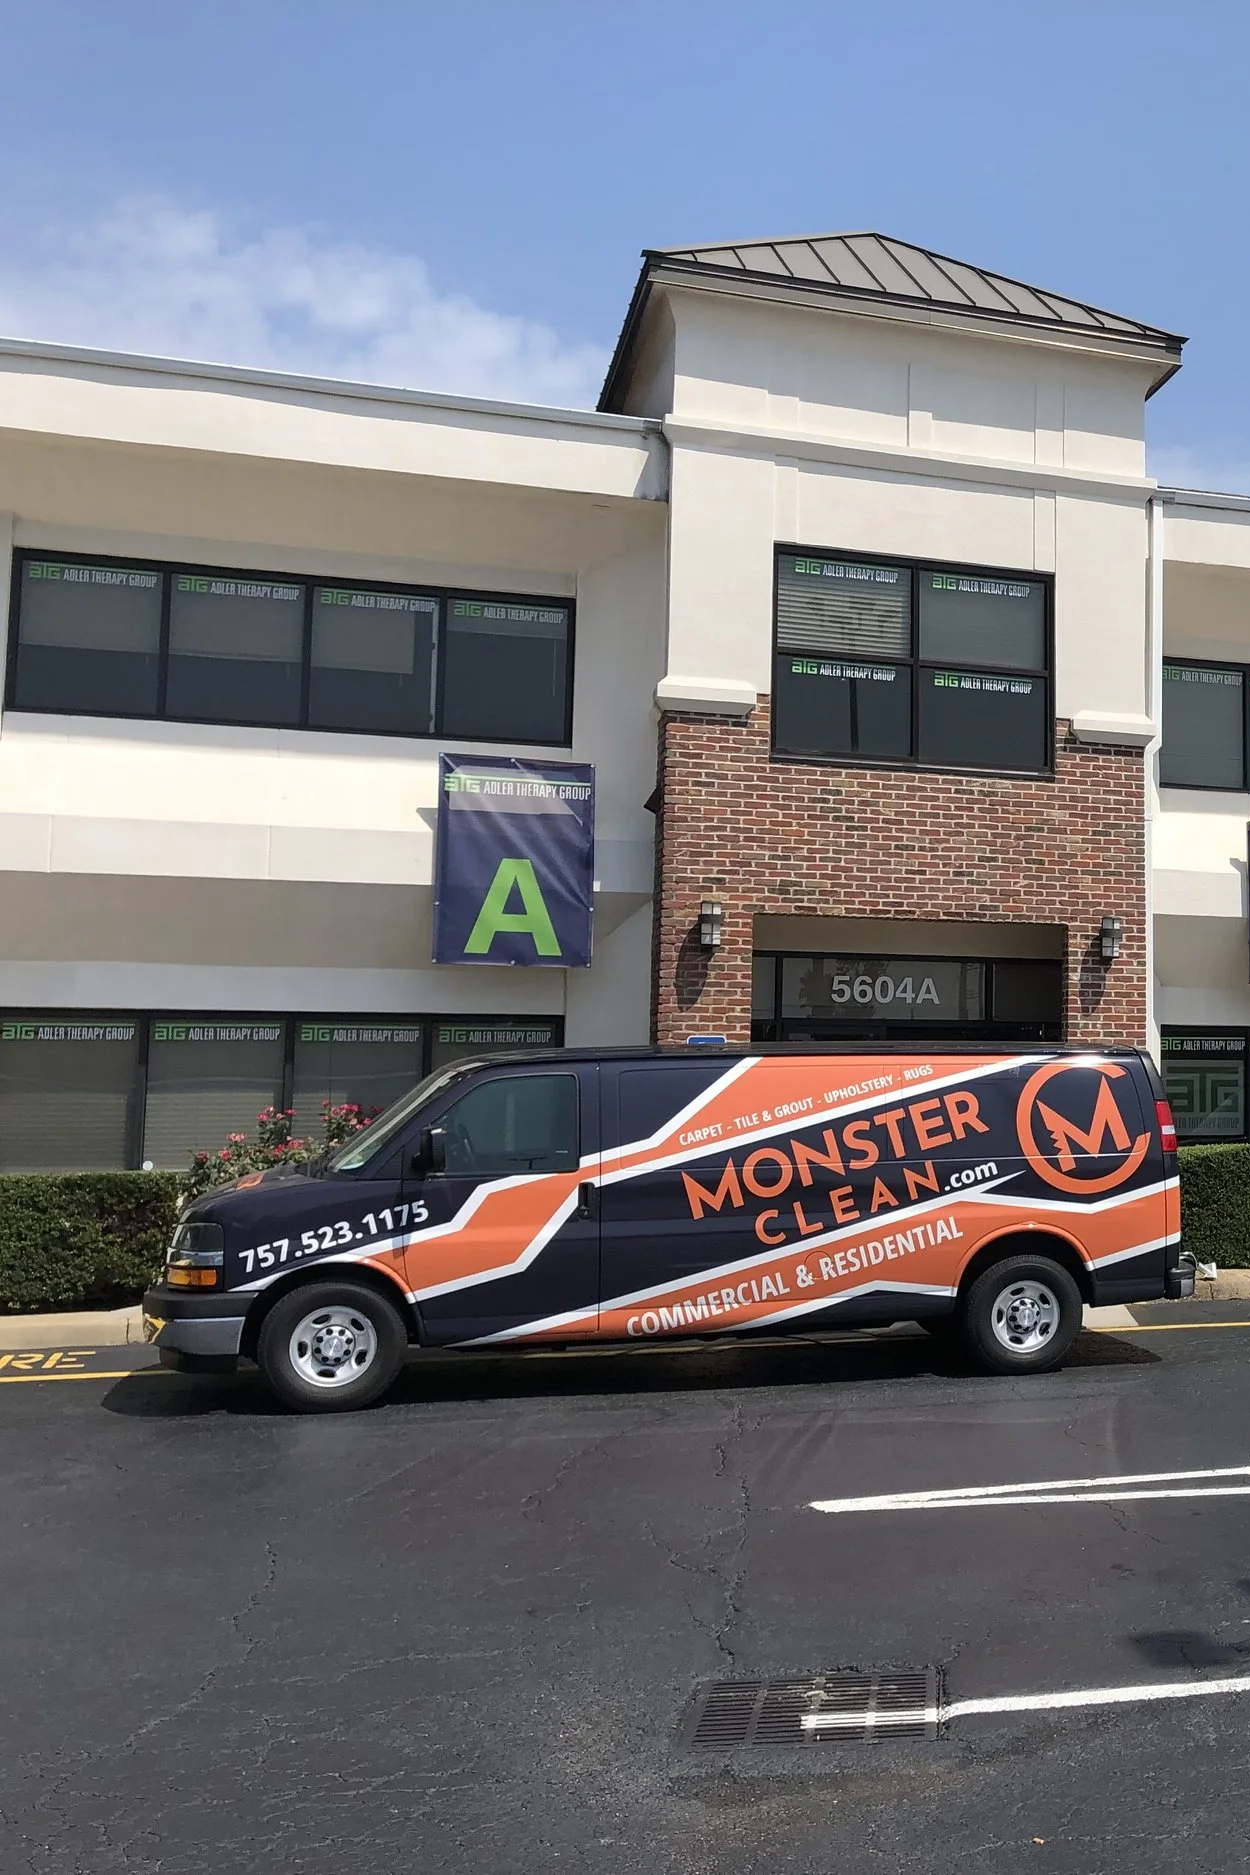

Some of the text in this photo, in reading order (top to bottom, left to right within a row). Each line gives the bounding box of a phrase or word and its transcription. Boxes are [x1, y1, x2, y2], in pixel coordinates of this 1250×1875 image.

[63, 569, 89, 582] ADLER
[91, 570, 127, 585] THERAPY
[129, 574, 157, 587] GROUP
[823, 564, 844, 577] ADLER
[846, 567, 874, 580] THERAPY
[876, 570, 898, 583] GROUP
[210, 582, 236, 595] ADLER
[238, 584, 271, 598] THERAPY
[273, 586, 299, 600] GROUP
[959, 580, 979, 592] ADLER
[980, 582, 1007, 595] THERAPY
[1008, 586, 1030, 597] GROUP
[351, 595, 375, 607] ADLER
[376, 597, 408, 611] THERAPY
[410, 599, 435, 612] GROUP
[484, 607, 506, 619] ADLER
[508, 608, 538, 621] THERAPY
[540, 611, 564, 623] GROUP
[820, 664, 841, 677] ADLER
[843, 666, 871, 679] THERAPY
[873, 669, 896, 682] GROUP
[1182, 671, 1199, 682] ADLER
[1200, 673, 1223, 684] THERAPY
[1225, 674, 1242, 686] GROUP
[961, 677, 980, 690] ADLER
[982, 679, 1009, 692] THERAPY
[1010, 682, 1032, 694] GROUP
[484, 781, 513, 796] ADLER
[515, 783, 558, 798] THERAPY
[560, 786, 591, 800] GROUP
[464, 858, 562, 956] A
[831, 975, 940, 1005] 5604A
[38, 1027, 65, 1040] ADLER
[67, 1028, 103, 1040] THERAPY
[106, 1028, 134, 1040] GROUP
[188, 1028, 214, 1040] ADLER
[216, 1028, 250, 1040] THERAPY
[253, 1028, 280, 1040] GROUP
[333, 1029, 357, 1041] ADLER
[359, 1030, 391, 1042] THERAPY
[394, 1030, 419, 1042] GROUP
[469, 1031, 491, 1042] ADLER
[493, 1031, 525, 1042] THERAPY
[527, 1032, 550, 1043] GROUP
[1183, 1041, 1200, 1050] ADLER
[1202, 1041, 1225, 1050] THERAPY
[1227, 1041, 1245, 1051] GROUP
[679, 1064, 934, 1146] CARPET TILE & GROUT UPHOLSTERY RUGS
[681, 1090, 990, 1220] MONSTER
[238, 1200, 429, 1273] 757.523.1175
[627, 1216, 964, 1337] COMMERCIAL & RESIDENTIAL
